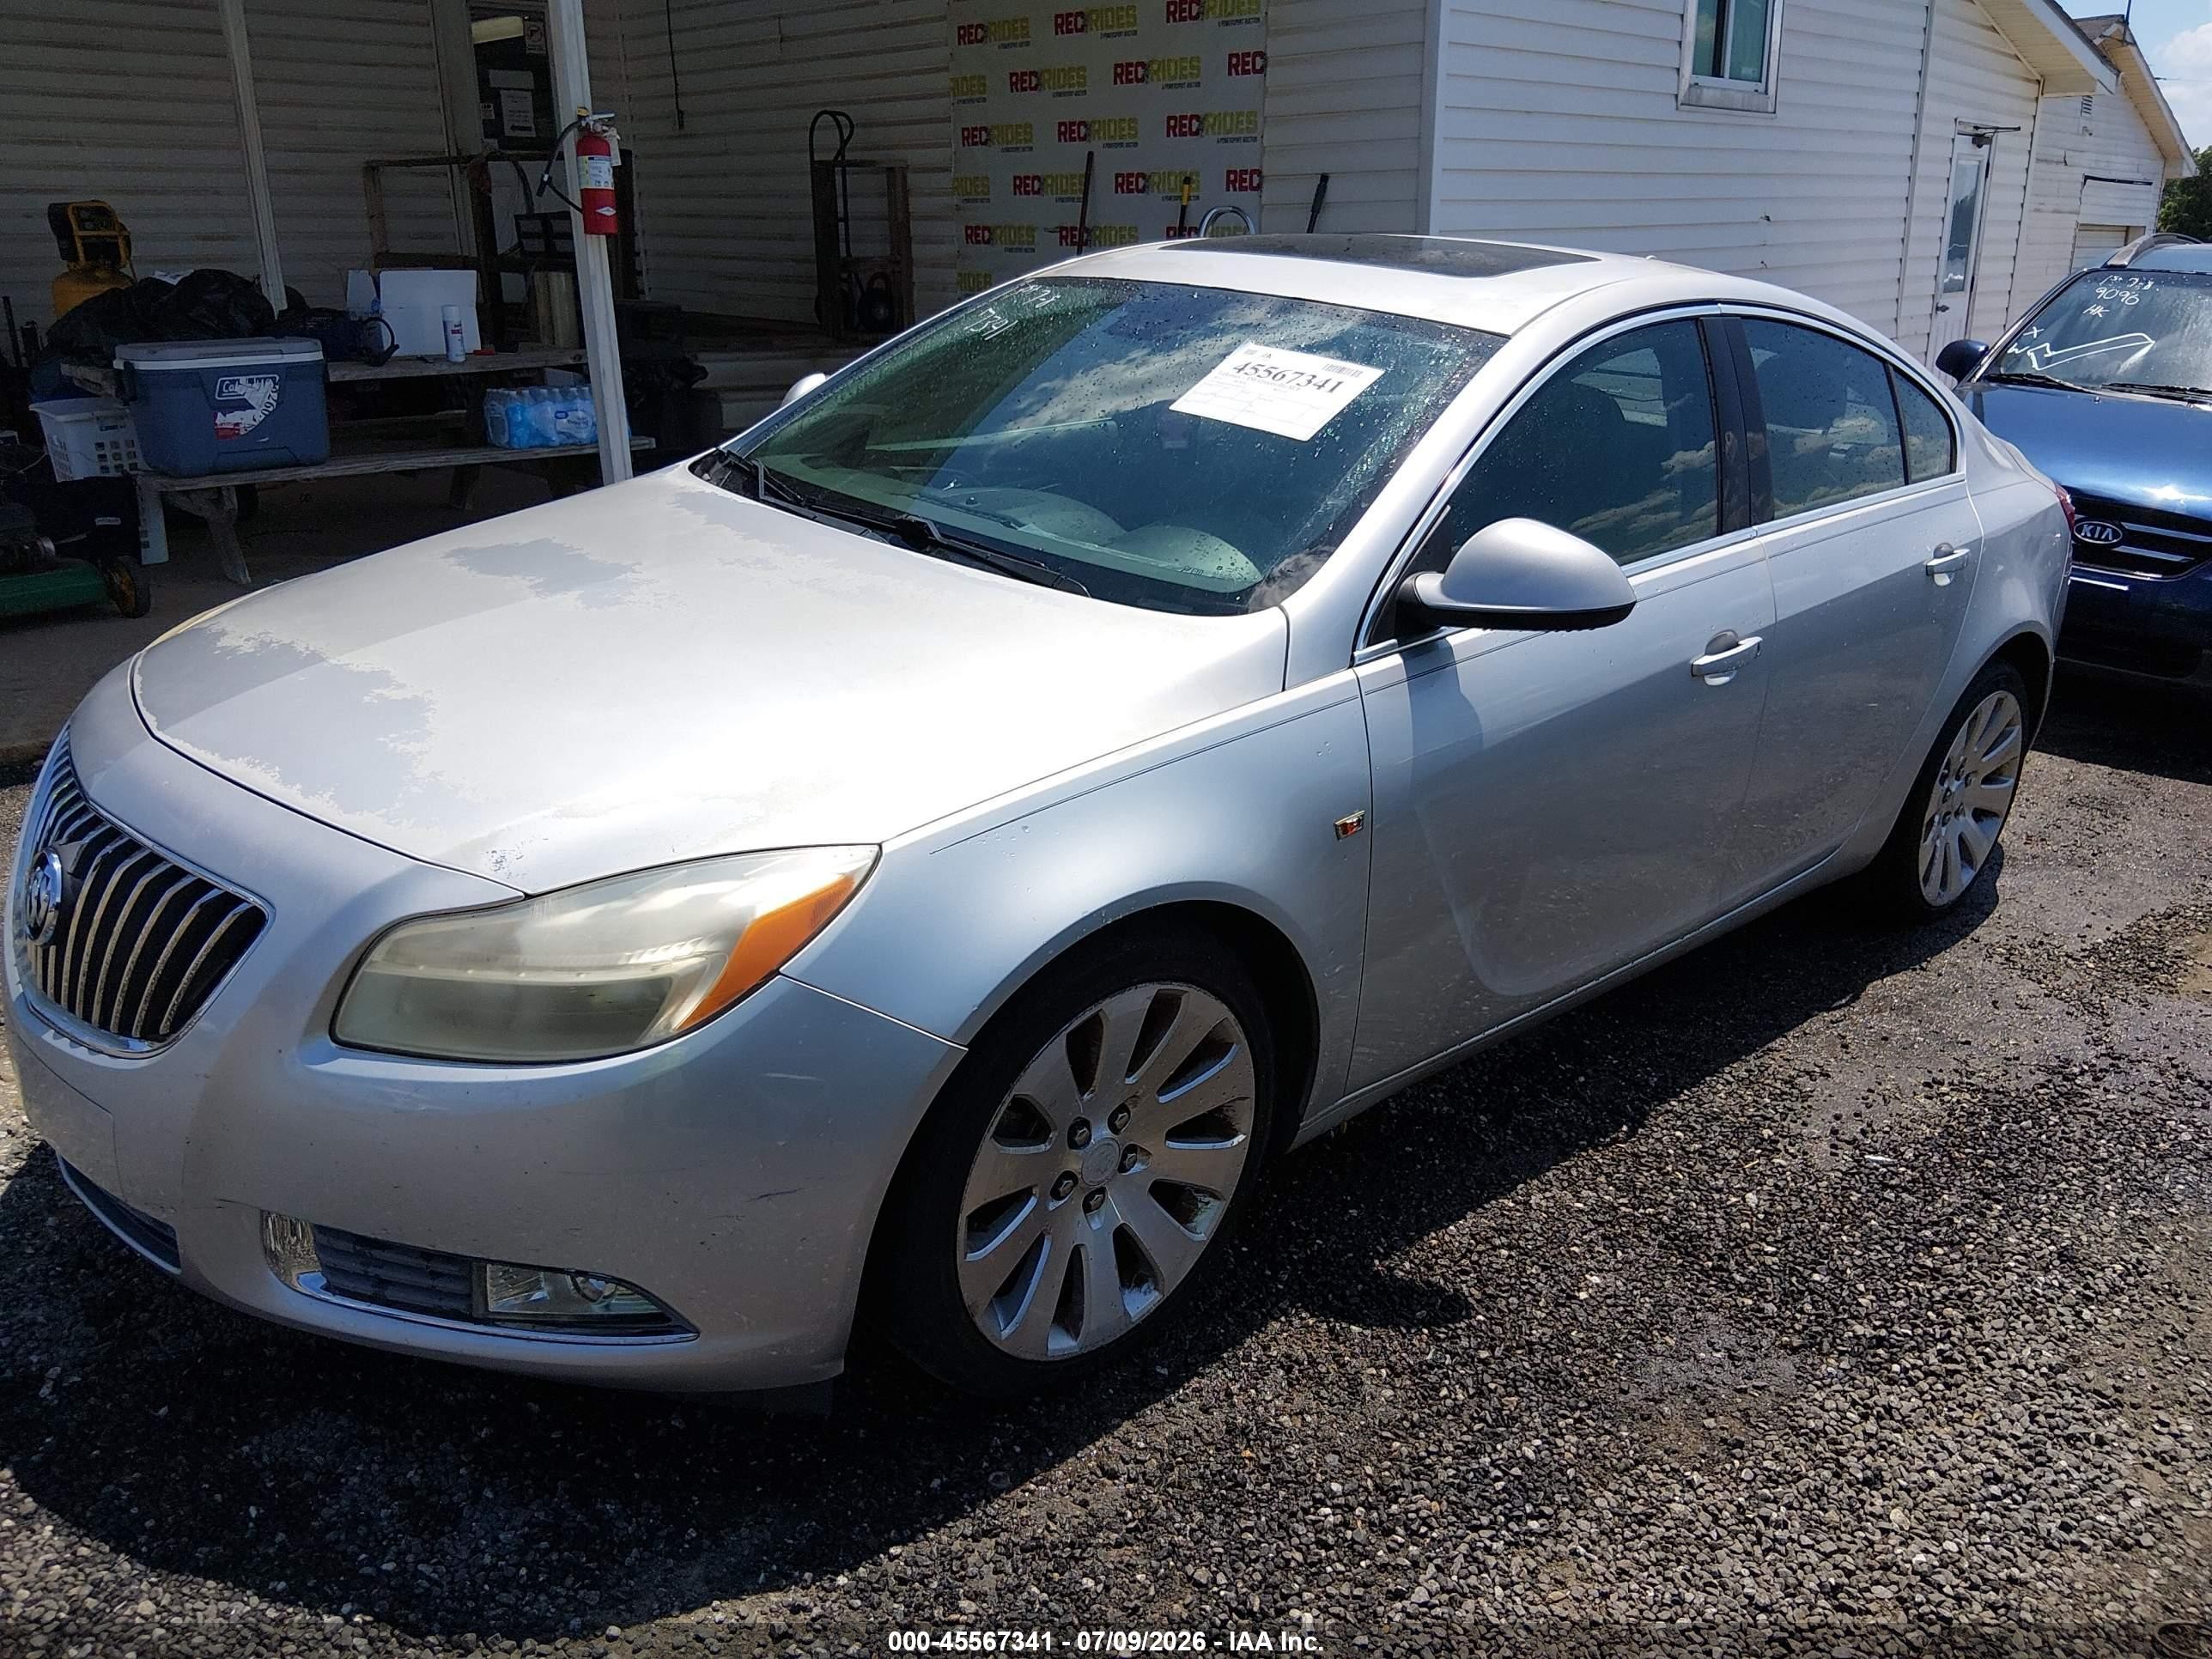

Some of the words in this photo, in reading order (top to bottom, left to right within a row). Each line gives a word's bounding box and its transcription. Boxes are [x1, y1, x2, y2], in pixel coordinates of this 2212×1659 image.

[2095, 287, 2139, 305] 9096
[1233, 362, 1345, 393] 45567341
[2081, 524, 2112, 541] KIA
